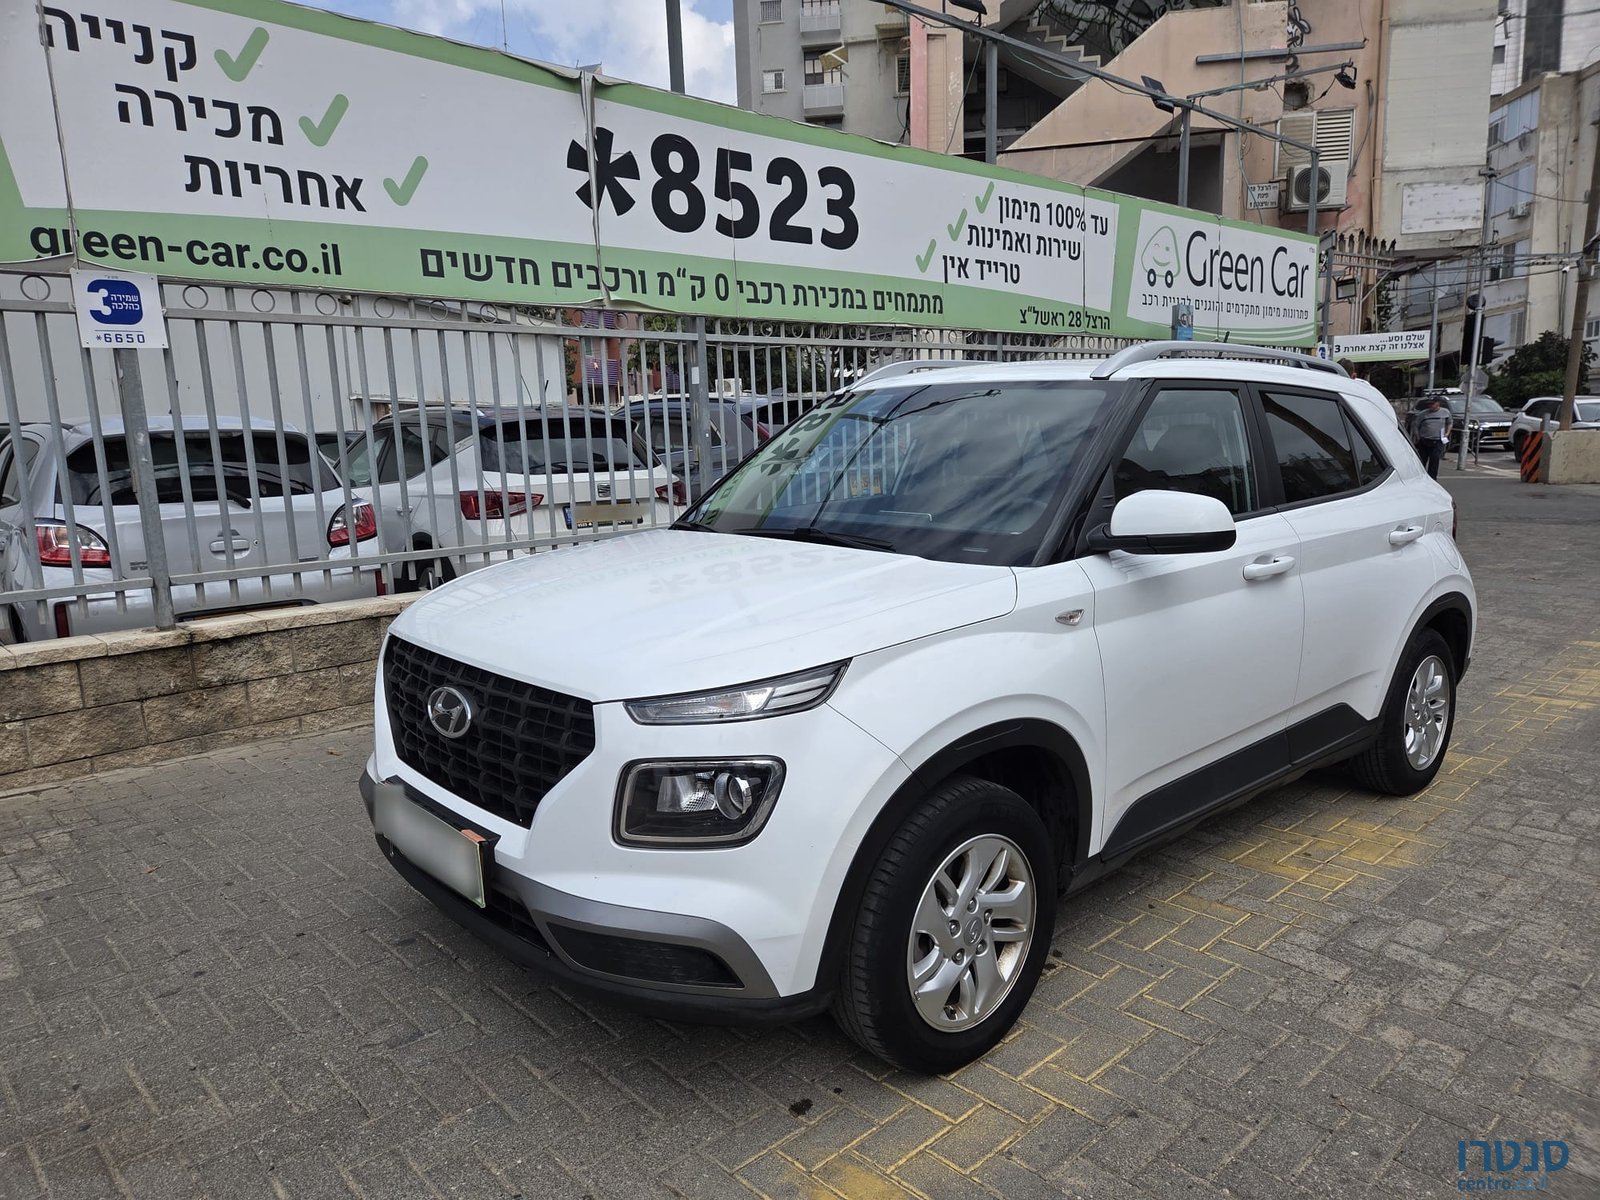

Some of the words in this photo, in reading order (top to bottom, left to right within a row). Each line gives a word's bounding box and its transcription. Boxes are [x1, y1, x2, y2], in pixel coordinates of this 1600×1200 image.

[41, 6, 197, 82] קנייה
[115, 83, 284, 146] מכירה
[184, 154, 367, 212] אחריות
[999, 195, 1040, 225] מימון
[1046, 202, 1087, 231] 100%
[1091, 215, 1109, 236] עד
[30, 226, 342, 276] green-car.co.il
[967, 223, 1031, 254] ואמינות
[1036, 236, 1081, 261] שירות
[420, 248, 540, 286] חדשים
[942, 255, 969, 284] אין
[975, 259, 1021, 284] טרייד
[1186, 231, 1264, 294] Green
[1271, 245, 1309, 299] Car
[552, 261, 647, 295] ורכבים
[715, 278, 729, 301] 0
[110, 294, 139, 302] שמירה
[736, 280, 786, 305] רכבי
[793, 282, 867, 310] במכירת
[873, 290, 943, 315] מתמחים
[1142, 293, 1159, 306] רכב
[111, 302, 140, 310] כהלכה
[1194, 298, 1224, 313] והוגנים
[1226, 301, 1260, 316] מתקדמים
[1262, 306, 1281, 319] מימון
[1282, 307, 1309, 320] פתרונות
[1068, 312, 1083, 329] 28
[1085, 311, 1111, 330] הרצל
[1369, 344, 1386, 352] קצת
[1401, 341, 1424, 349] אצלנו
[1405, 333, 1425, 341] שלם
